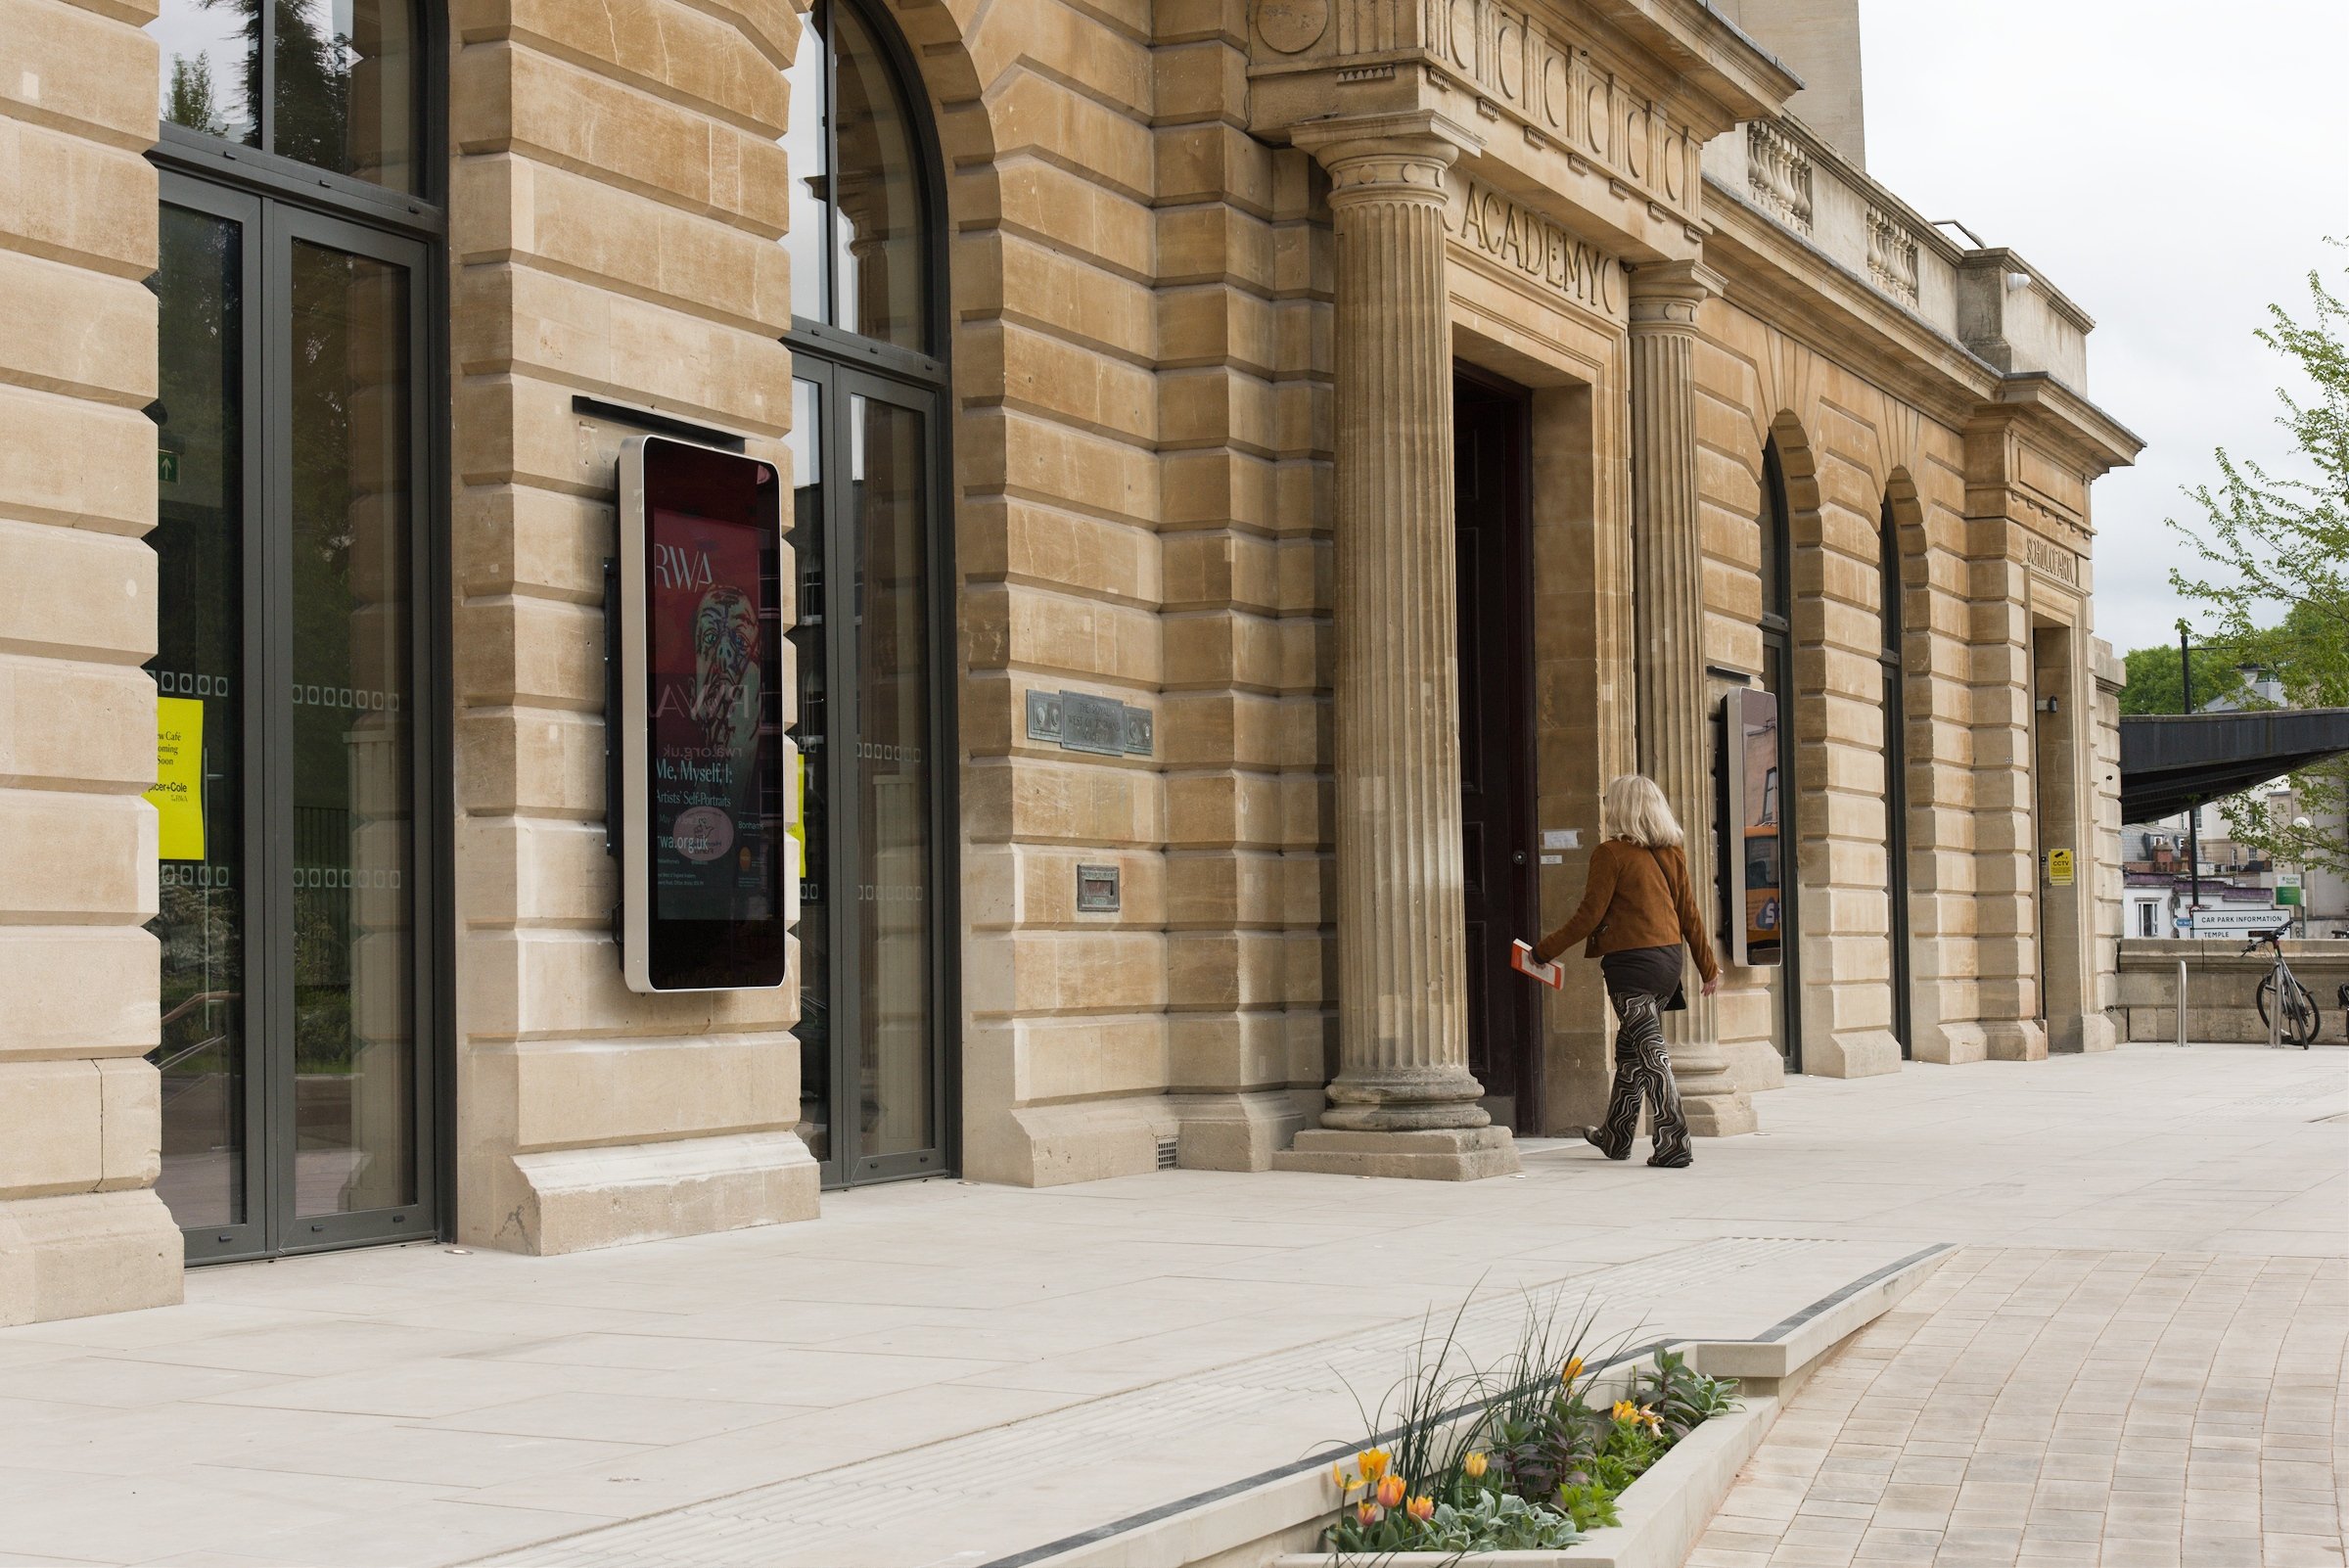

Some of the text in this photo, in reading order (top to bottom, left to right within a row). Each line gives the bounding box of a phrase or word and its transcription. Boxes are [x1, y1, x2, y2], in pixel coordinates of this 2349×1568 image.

[1460, 182, 1600, 306] ACADEMY
[655, 542, 714, 593] RWA
[165, 731, 182, 742] Café
[158, 744, 178, 756] oming
[158, 756, 174, 765] Soon
[657, 758, 677, 782] Me,
[680, 760, 722, 787] Myself,
[149, 781, 188, 793] cer+Cole
[683, 791, 731, 807] Self-Portraits
